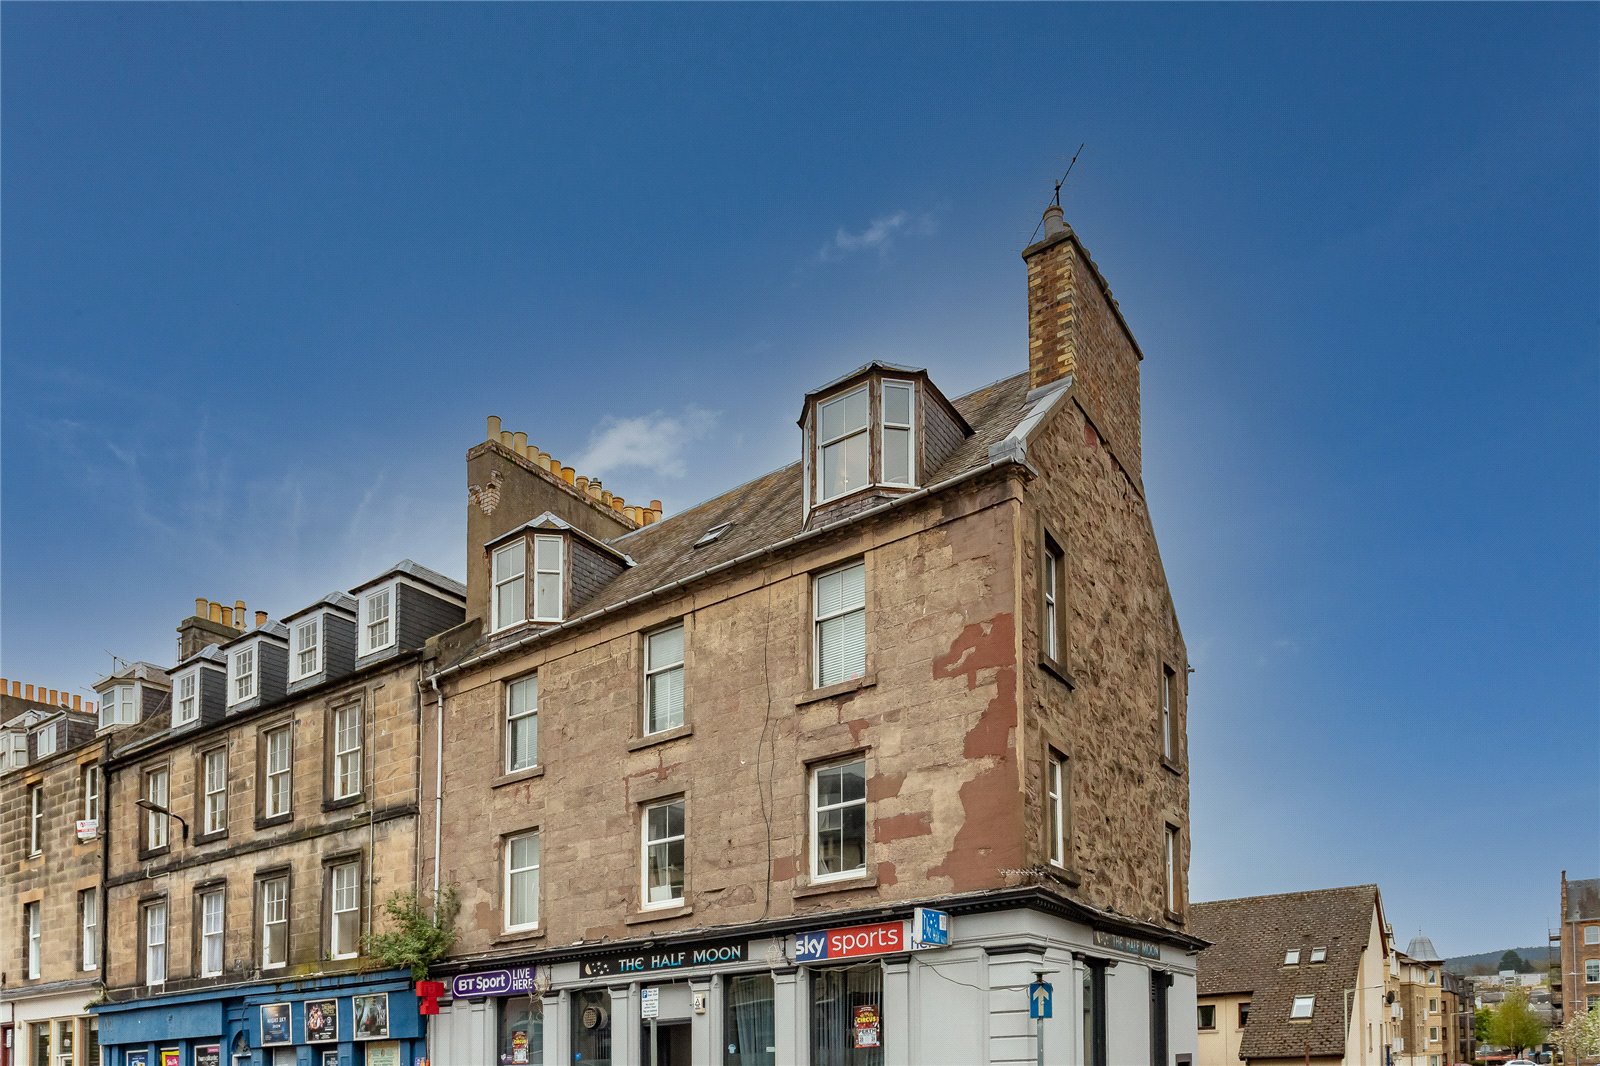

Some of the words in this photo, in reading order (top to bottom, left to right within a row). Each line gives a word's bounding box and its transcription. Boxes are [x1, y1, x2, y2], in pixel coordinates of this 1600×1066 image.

[796, 935, 825, 958] sky
[832, 928, 898, 954] sports
[1112, 934, 1124, 949] THE
[1126, 937, 1140, 953] HALF
[1141, 941, 1159, 956] MOON
[619, 957, 644, 972] THE
[651, 952, 686, 969] HALF
[693, 945, 741, 964] MOON
[458, 978, 475, 991] BT
[476, 974, 506, 992] Sport
[512, 968, 530, 979] LIVE
[512, 978, 533, 991] HERE
